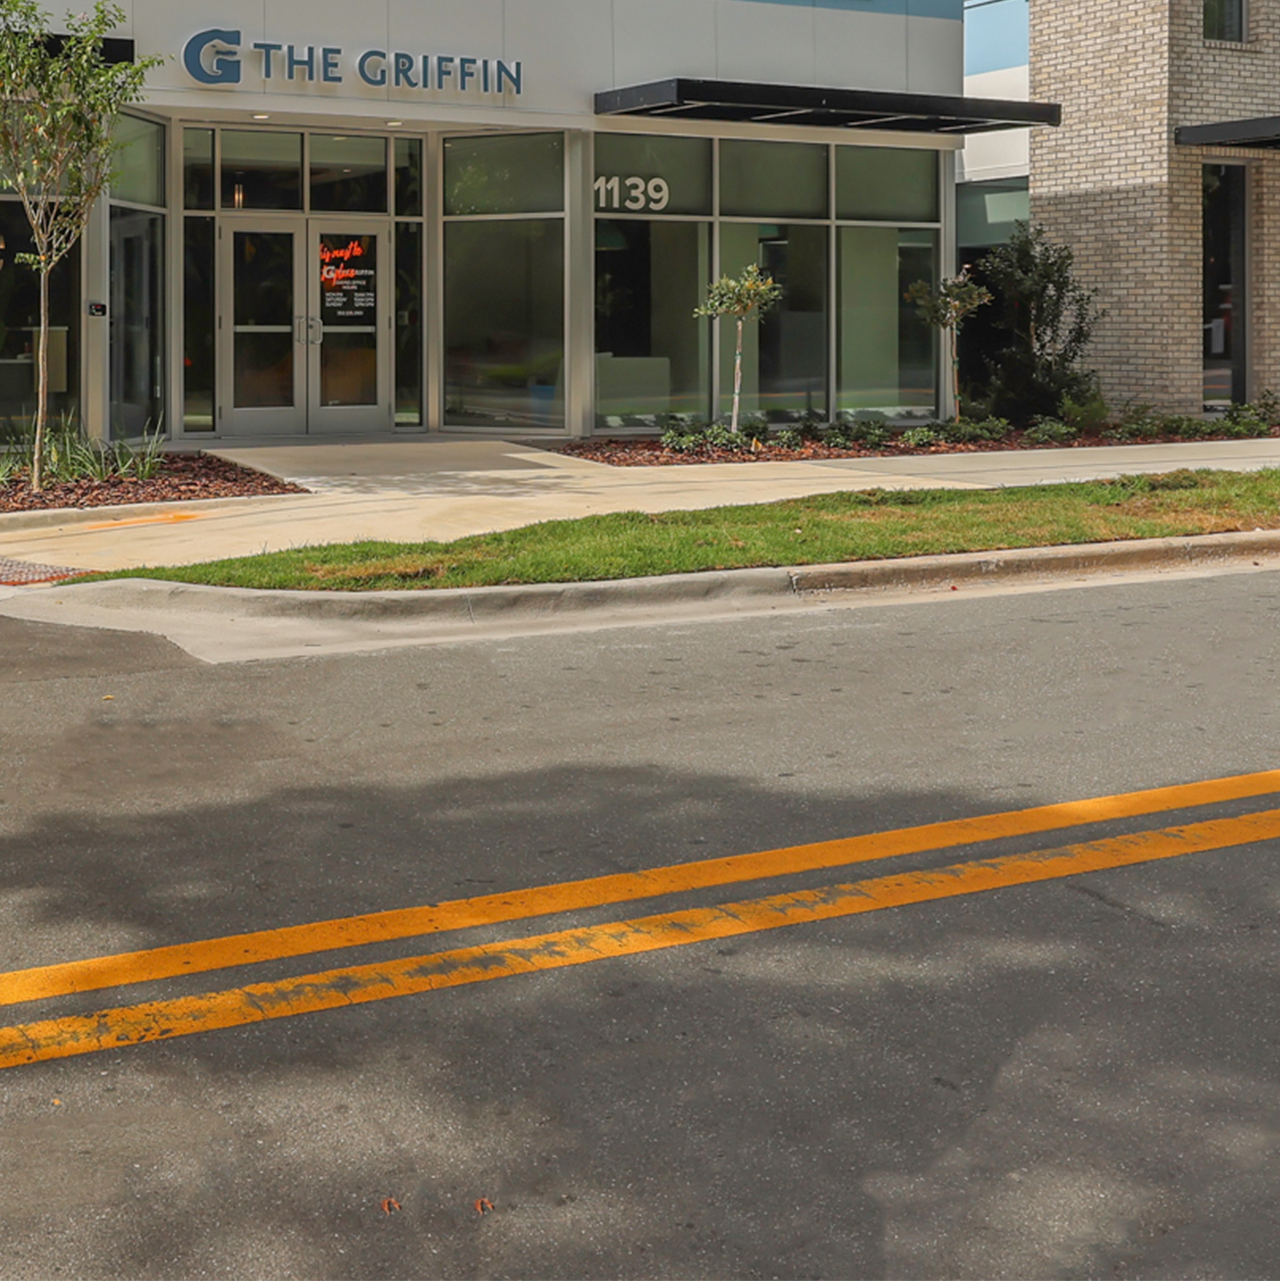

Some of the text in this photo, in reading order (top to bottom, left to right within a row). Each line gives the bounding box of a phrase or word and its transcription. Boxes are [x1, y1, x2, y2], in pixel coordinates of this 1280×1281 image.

[252, 42, 343, 83] THE
[357, 49, 522, 95] GRIFFIN
[593, 176, 669, 211] 1139
